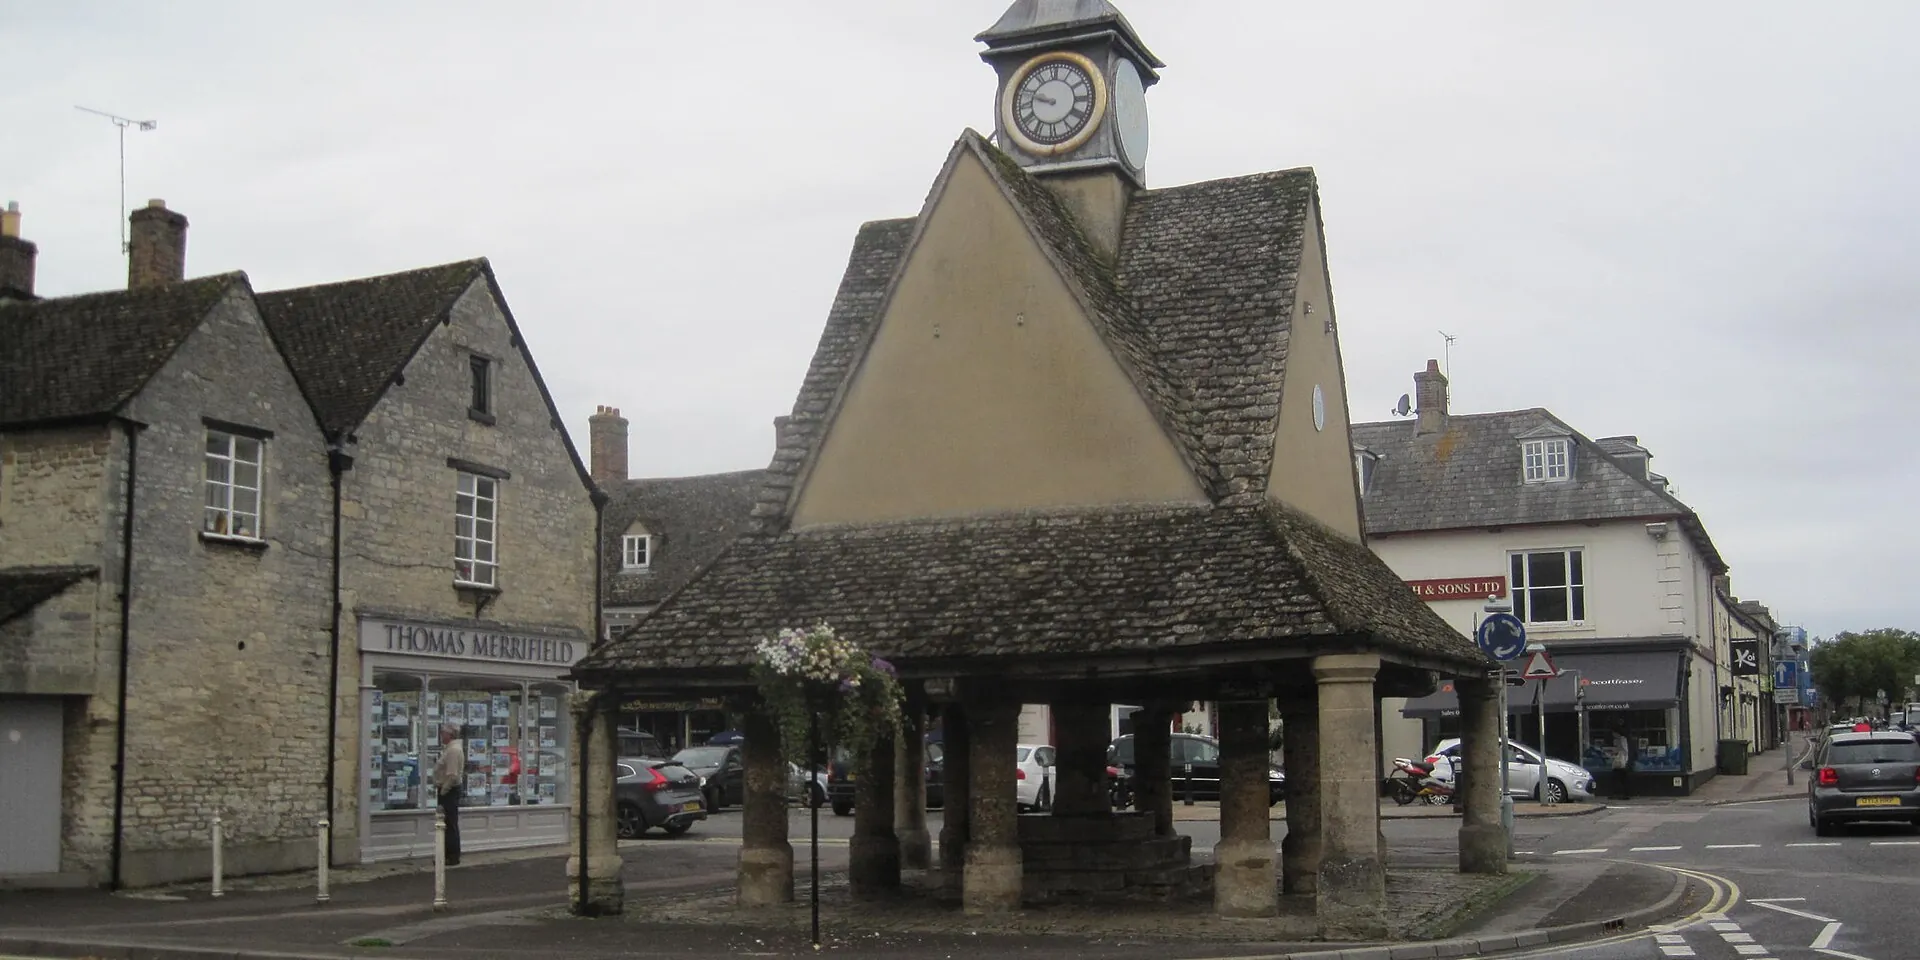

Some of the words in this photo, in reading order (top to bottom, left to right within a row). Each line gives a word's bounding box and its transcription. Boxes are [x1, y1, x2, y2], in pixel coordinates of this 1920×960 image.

[1425, 584, 1434, 595] &
[1438, 583, 1471, 594] SONS
[1474, 582, 1500, 593] LTD
[384, 624, 465, 656] THOMAS
[472, 631, 573, 664] MERRIFIELD
[1734, 648, 1757, 669] Koi
